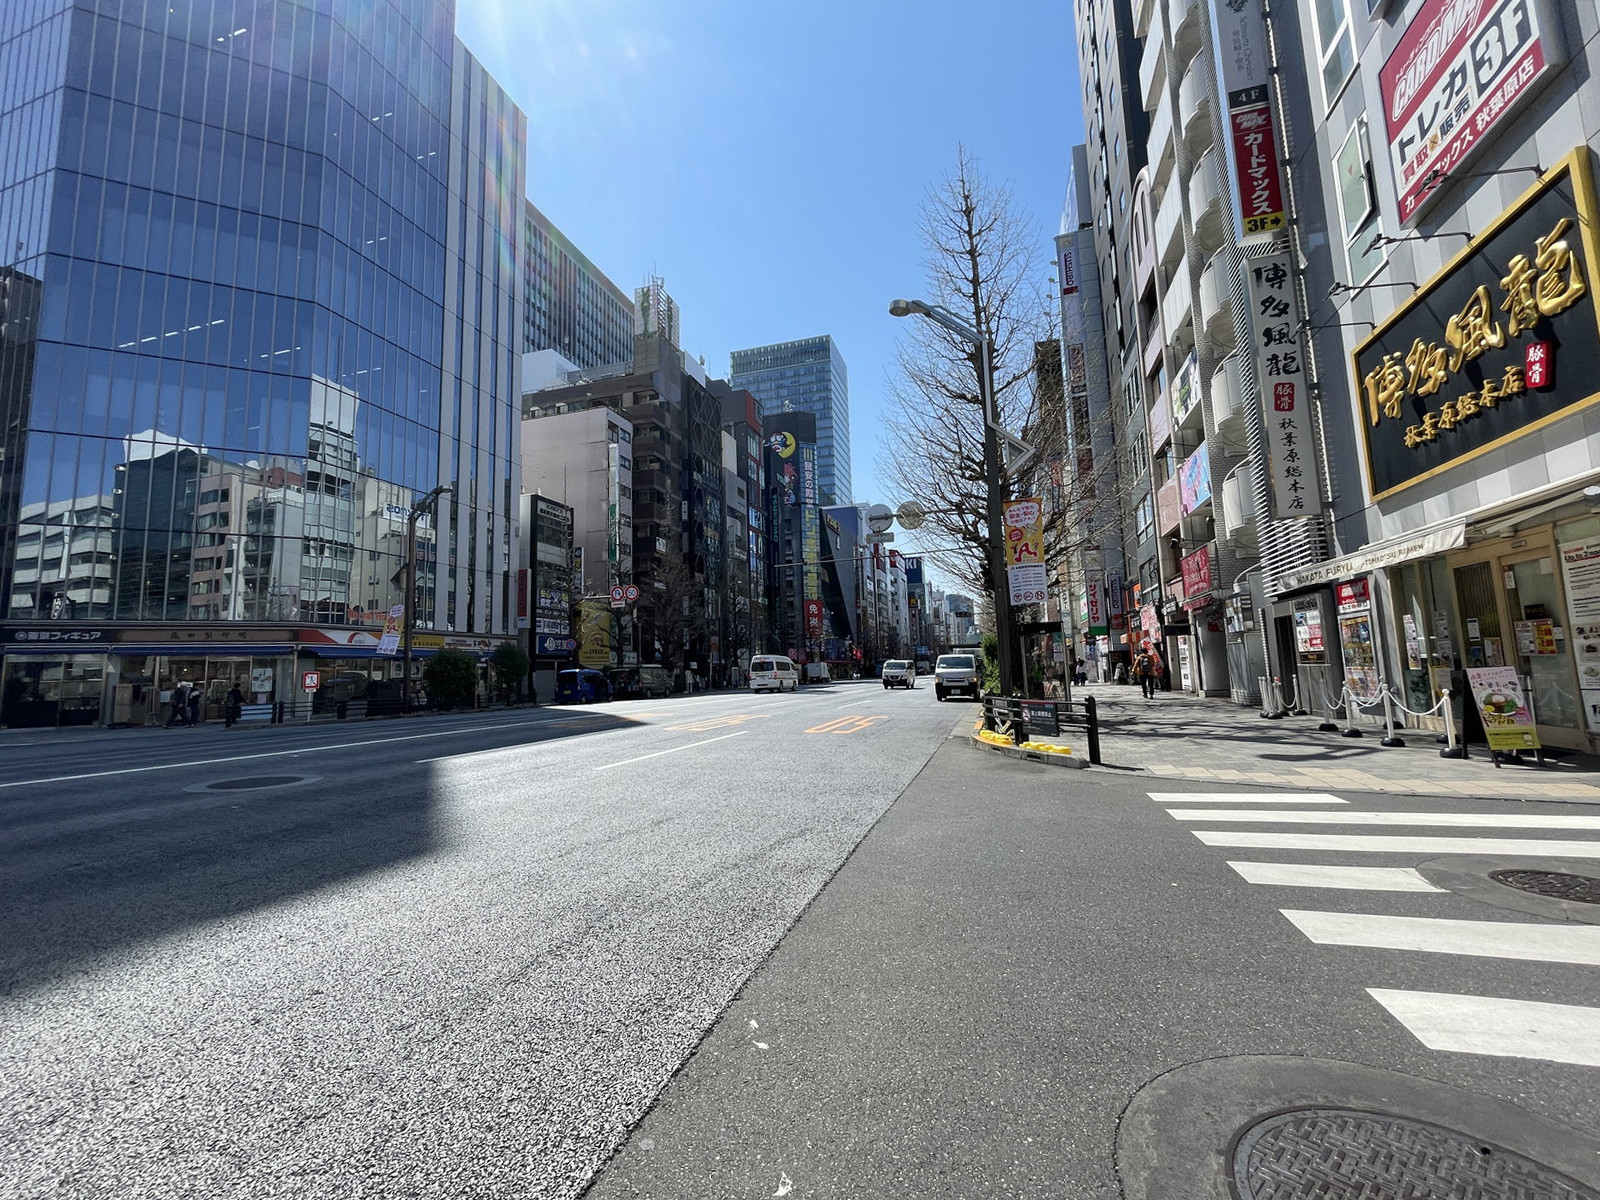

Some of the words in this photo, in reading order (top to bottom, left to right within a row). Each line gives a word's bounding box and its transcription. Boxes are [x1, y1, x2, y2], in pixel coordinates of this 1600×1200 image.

[1475, 0, 1523, 85] 3F
[1238, 89, 1259, 102] 4F
[1398, 60, 1468, 167] トレカ
[1439, 92, 1470, 141] 販売
[1475, 55, 1535, 132] 秋葉原店
[1243, 132, 1273, 216] カードマックス
[1247, 217, 1269, 233] 3F
[1064, 251, 1074, 287] SUSHIRO
[1251, 263, 1301, 377] 博多風龍
[1363, 218, 1587, 427] 博多風龍
[1525, 343, 1544, 385] 豚骨
[1275, 384, 1293, 411] 豚骨
[1404, 365, 1527, 449] 秋葉原総本店
[1278, 417, 1305, 512] 秋葉原総本店
[1088, 583, 1100, 623] サイゼリヤ
[1296, 572, 1324, 585] HAKATA
[1325, 562, 1353, 578] FURYU
